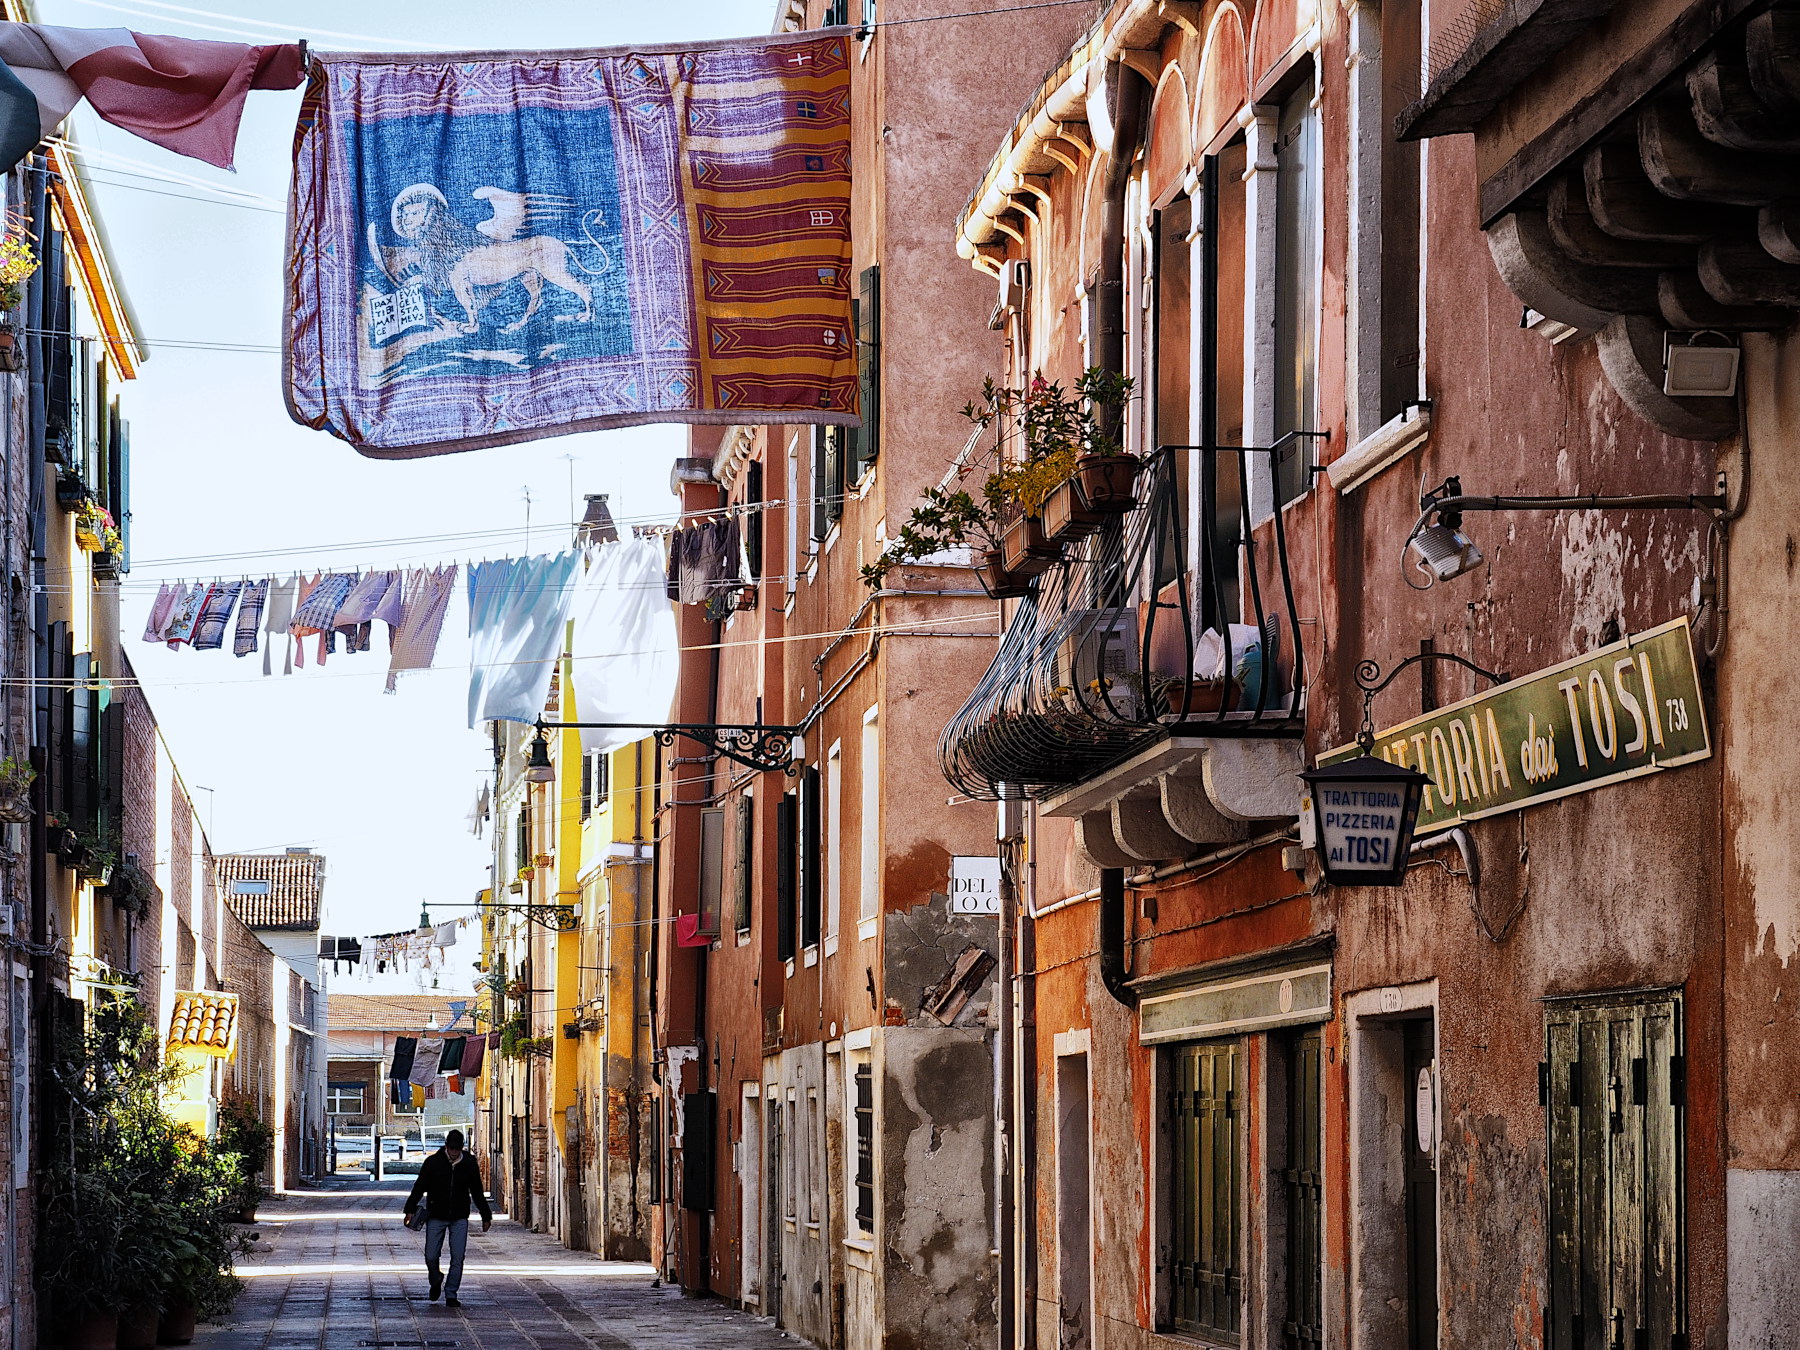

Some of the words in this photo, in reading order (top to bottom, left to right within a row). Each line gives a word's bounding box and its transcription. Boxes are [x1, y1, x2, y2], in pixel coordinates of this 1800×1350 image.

[375, 295, 393, 310] PAX
[400, 295, 421, 308] GELI
[375, 305, 394, 317] TIBI
[400, 305, 420, 316] STA
[376, 314, 395, 328] MAR
[1521, 713, 1559, 785] dai
[1558, 651, 1665, 771] TOSI
[1666, 697, 1689, 733] 738
[1323, 790, 1400, 808] TRATTORIA
[1326, 812, 1395, 831] PIZZERIA
[1330, 847, 1343, 862] AI
[1345, 835, 1389, 864] TOSI
[954, 877, 992, 893] DEL
